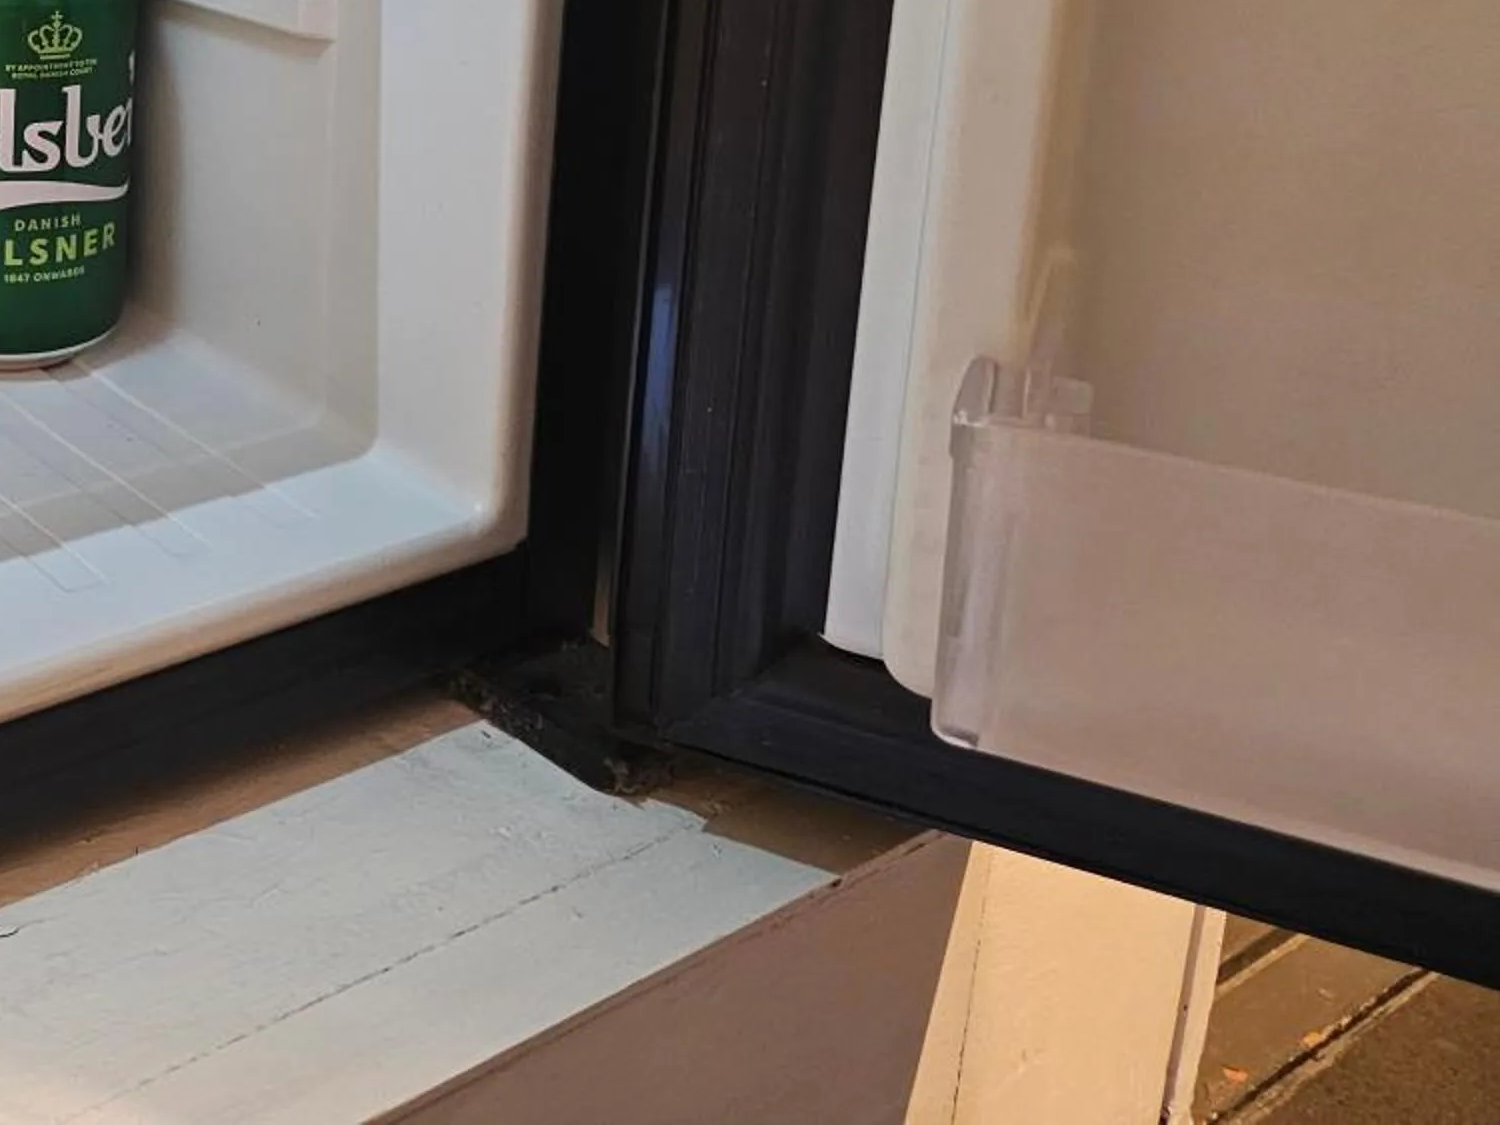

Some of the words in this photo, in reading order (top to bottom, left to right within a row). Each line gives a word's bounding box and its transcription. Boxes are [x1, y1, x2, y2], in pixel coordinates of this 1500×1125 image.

[14, 212, 81, 232] DANISH
[4, 272, 30, 284] 1847
[33, 265, 85, 283] ONWARDS
